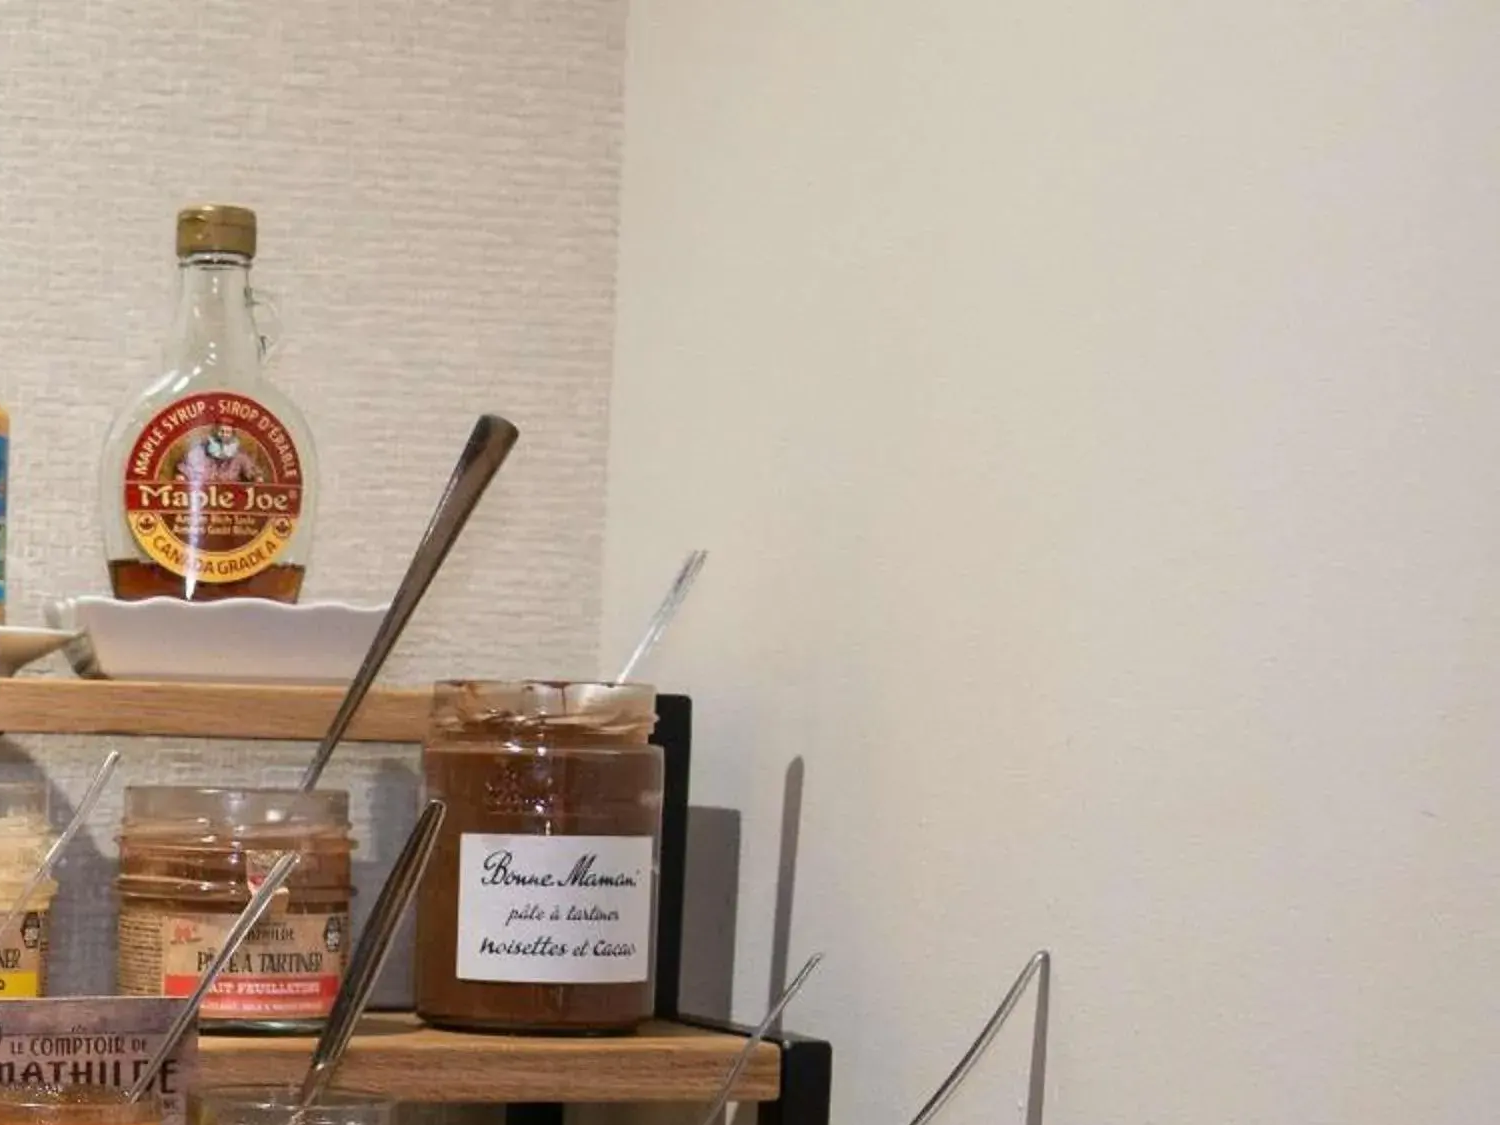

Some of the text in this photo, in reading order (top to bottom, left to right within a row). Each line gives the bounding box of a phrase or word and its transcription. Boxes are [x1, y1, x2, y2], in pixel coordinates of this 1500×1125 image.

[135, 426, 165, 475] MAPLE
[163, 401, 205, 432] SYRUP
[219, 400, 259, 421] SIROP
[138, 485, 289, 511] Maple Joe
[217, 549, 265, 576] GRADE
[265, 540, 277, 555] A
[481, 850, 637, 888] Bonne Maman
[505, 903, 619, 926] pâte à tartiner
[478, 937, 567, 957] noisettes
[572, 940, 590, 957] et
[30, 1036, 128, 1056] COMPTOIR
